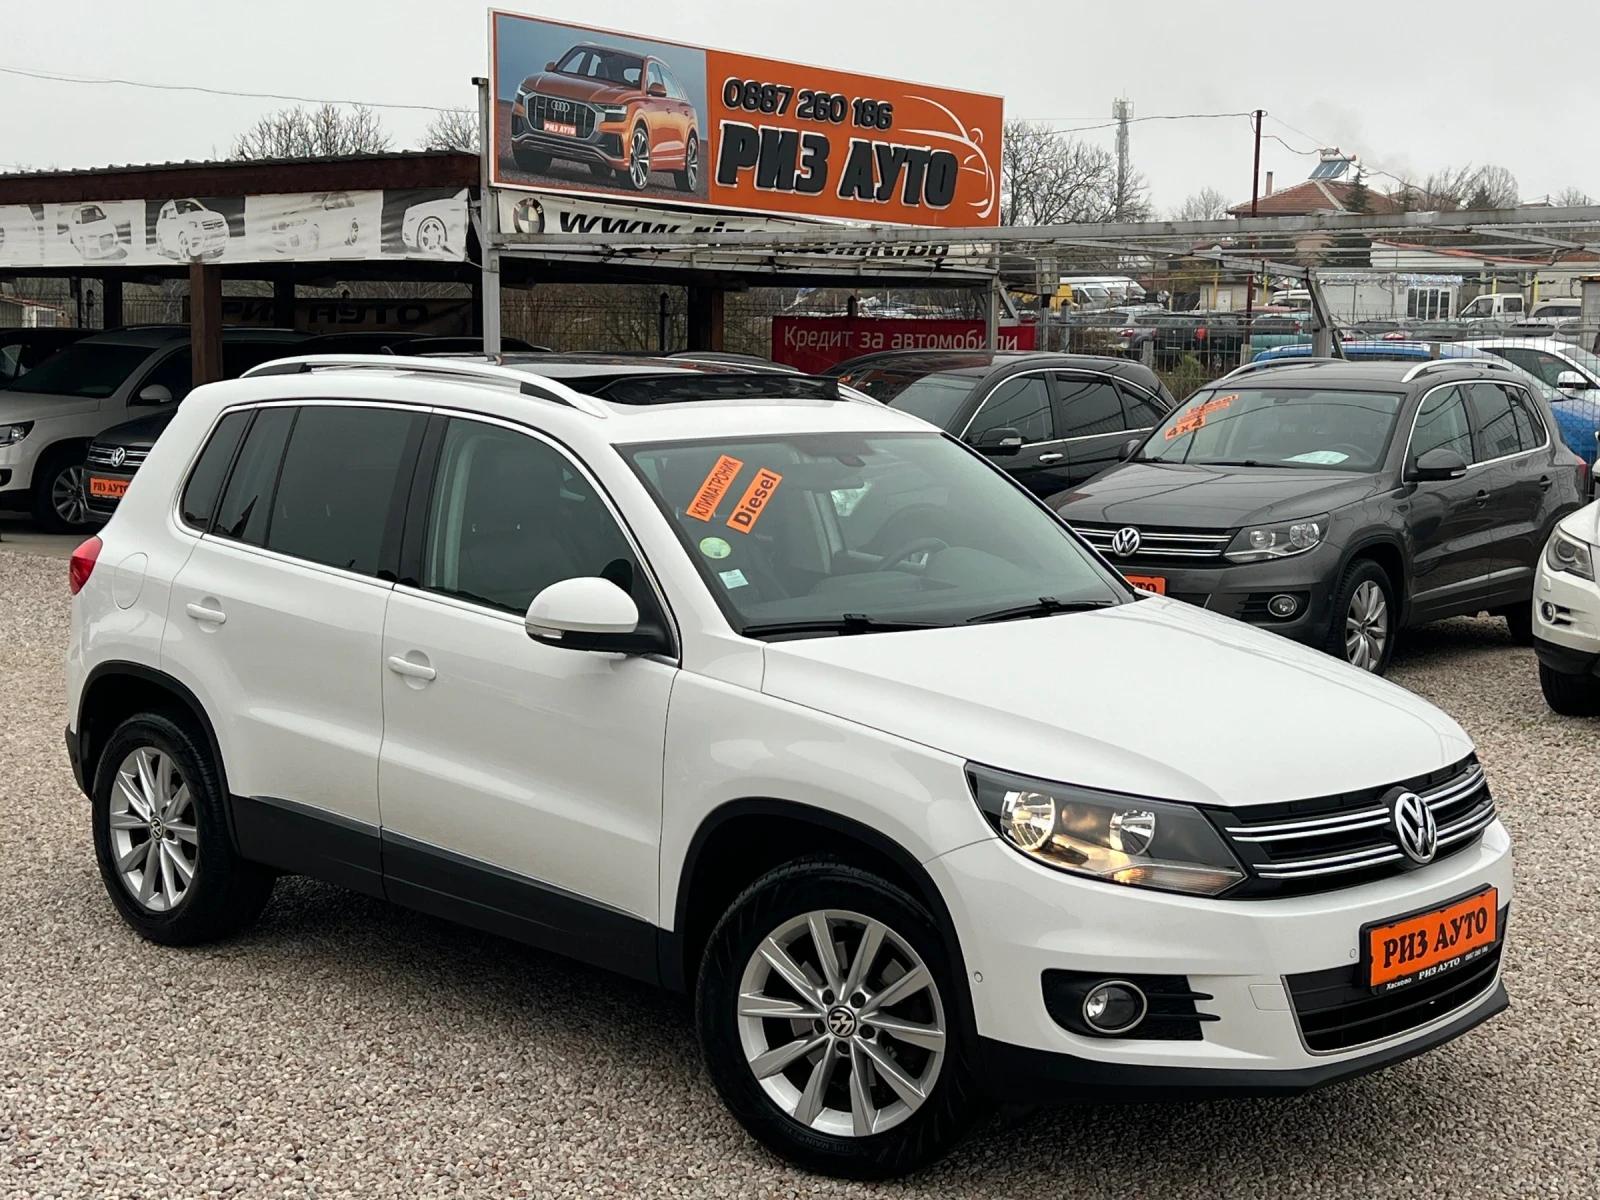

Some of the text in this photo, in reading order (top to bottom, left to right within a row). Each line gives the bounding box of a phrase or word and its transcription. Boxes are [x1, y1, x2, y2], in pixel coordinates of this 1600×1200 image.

[723, 76, 894, 131] 0887 260 186
[715, 119, 959, 210] РИЗ АУТО
[784, 325, 854, 350] Кредит
[859, 331, 884, 349] за
[733, 472, 777, 527] Diesel
[1383, 907, 1488, 968] РИЗ АУТО
[1418, 967, 1437, 981] РИЗ
[1437, 957, 1461, 973] АУТО
